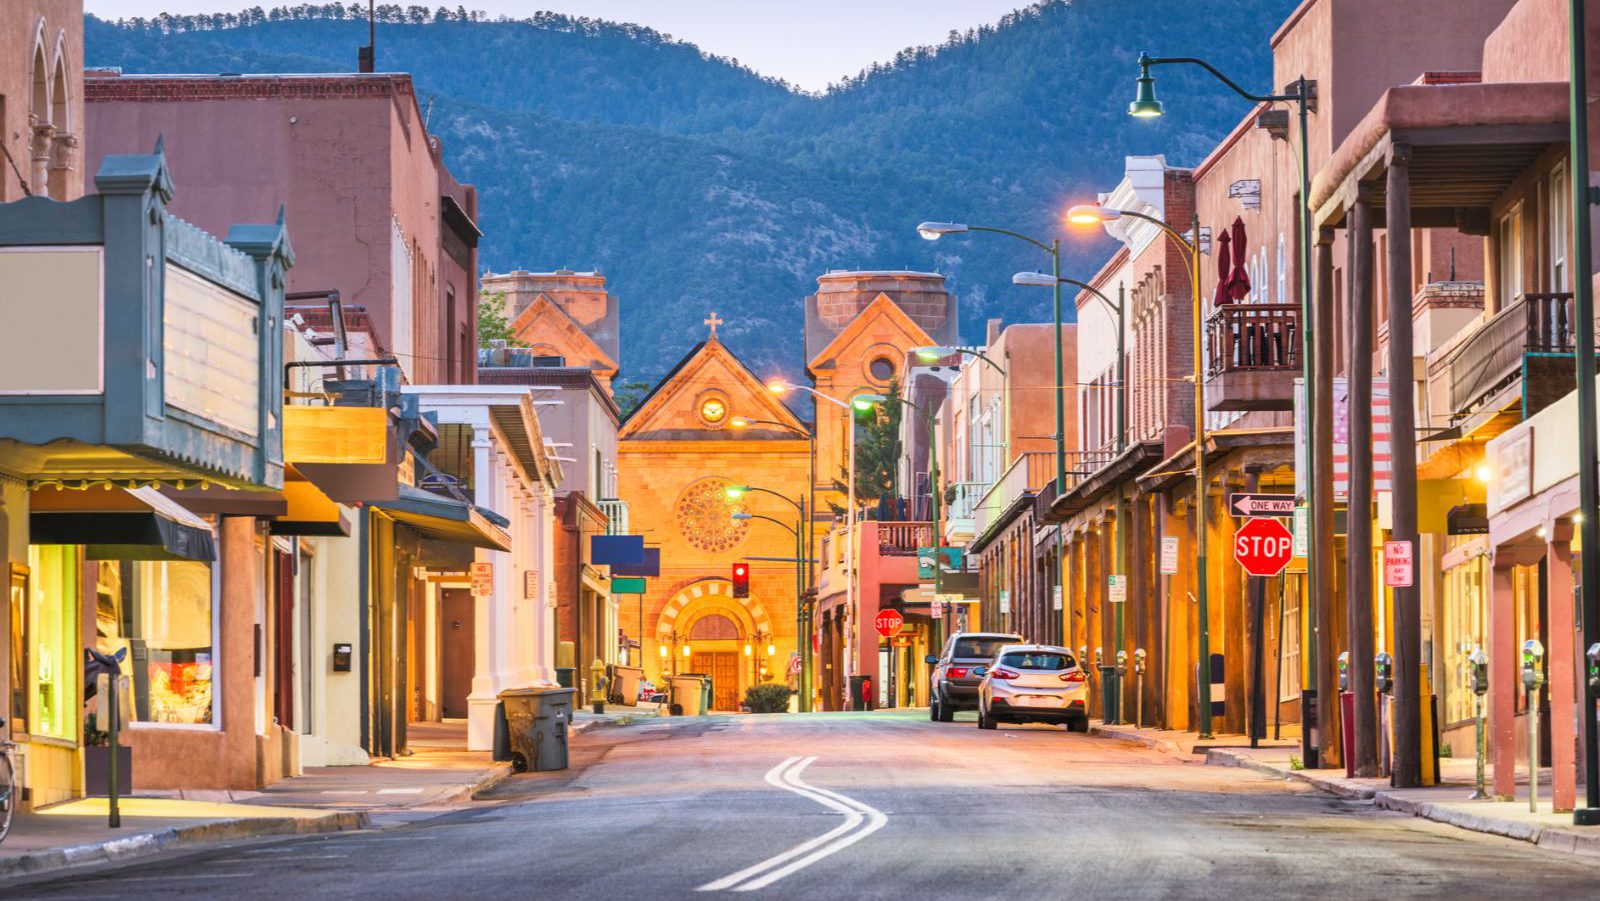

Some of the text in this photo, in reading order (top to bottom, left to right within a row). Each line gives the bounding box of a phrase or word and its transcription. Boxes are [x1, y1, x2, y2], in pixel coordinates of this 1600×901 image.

[1251, 501, 1292, 510] ONE WAY
[1237, 536, 1290, 558] STOP
[1393, 546, 1404, 555] NO
[1386, 557, 1411, 566] PARKING
[876, 617, 901, 629] STOP
